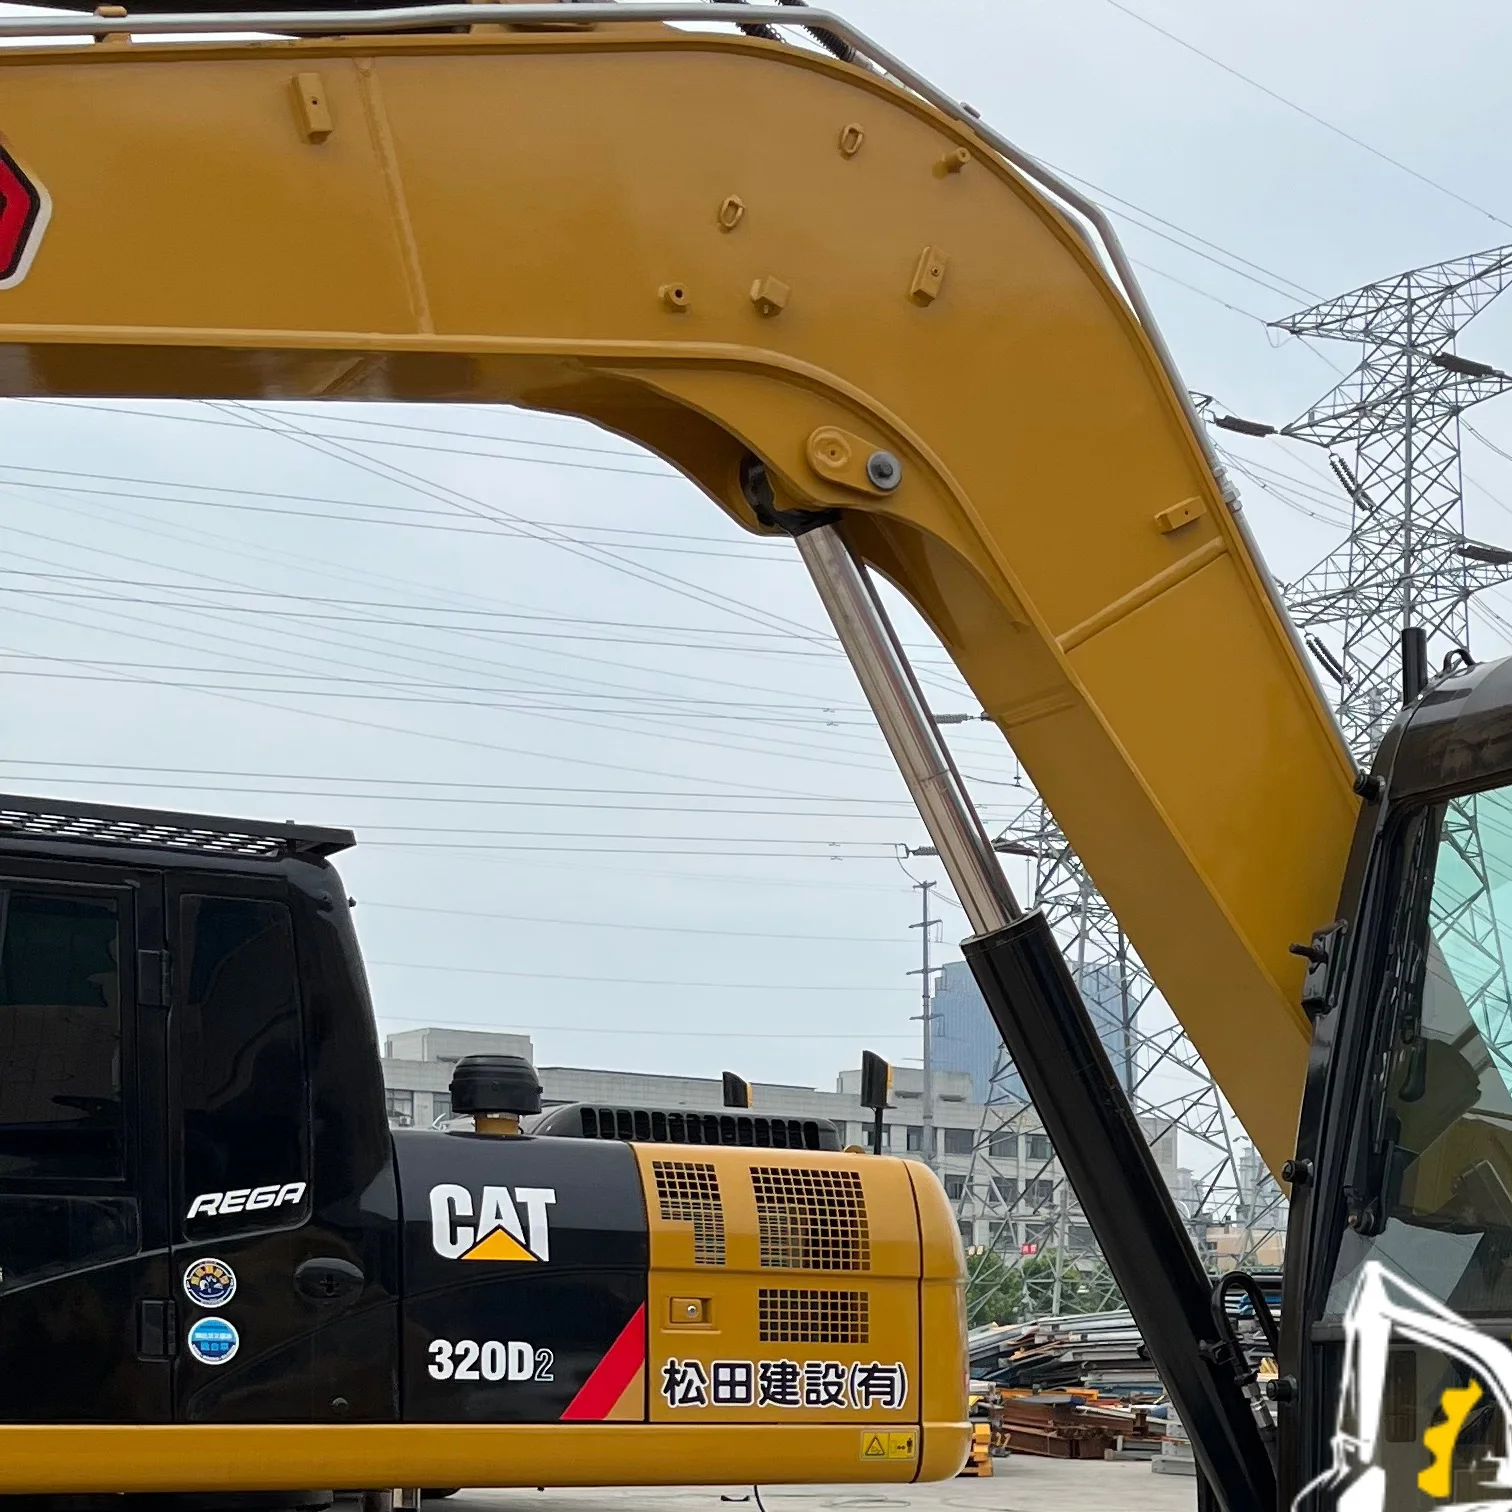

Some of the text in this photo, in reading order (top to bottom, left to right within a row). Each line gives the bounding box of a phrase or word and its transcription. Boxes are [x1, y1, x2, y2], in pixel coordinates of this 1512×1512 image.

[186, 1181, 307, 1219] REGA
[429, 1183, 557, 1262] CAT
[427, 1338, 555, 1382] 320D2
[661, 1357, 908, 1410] 松田建設(有)
